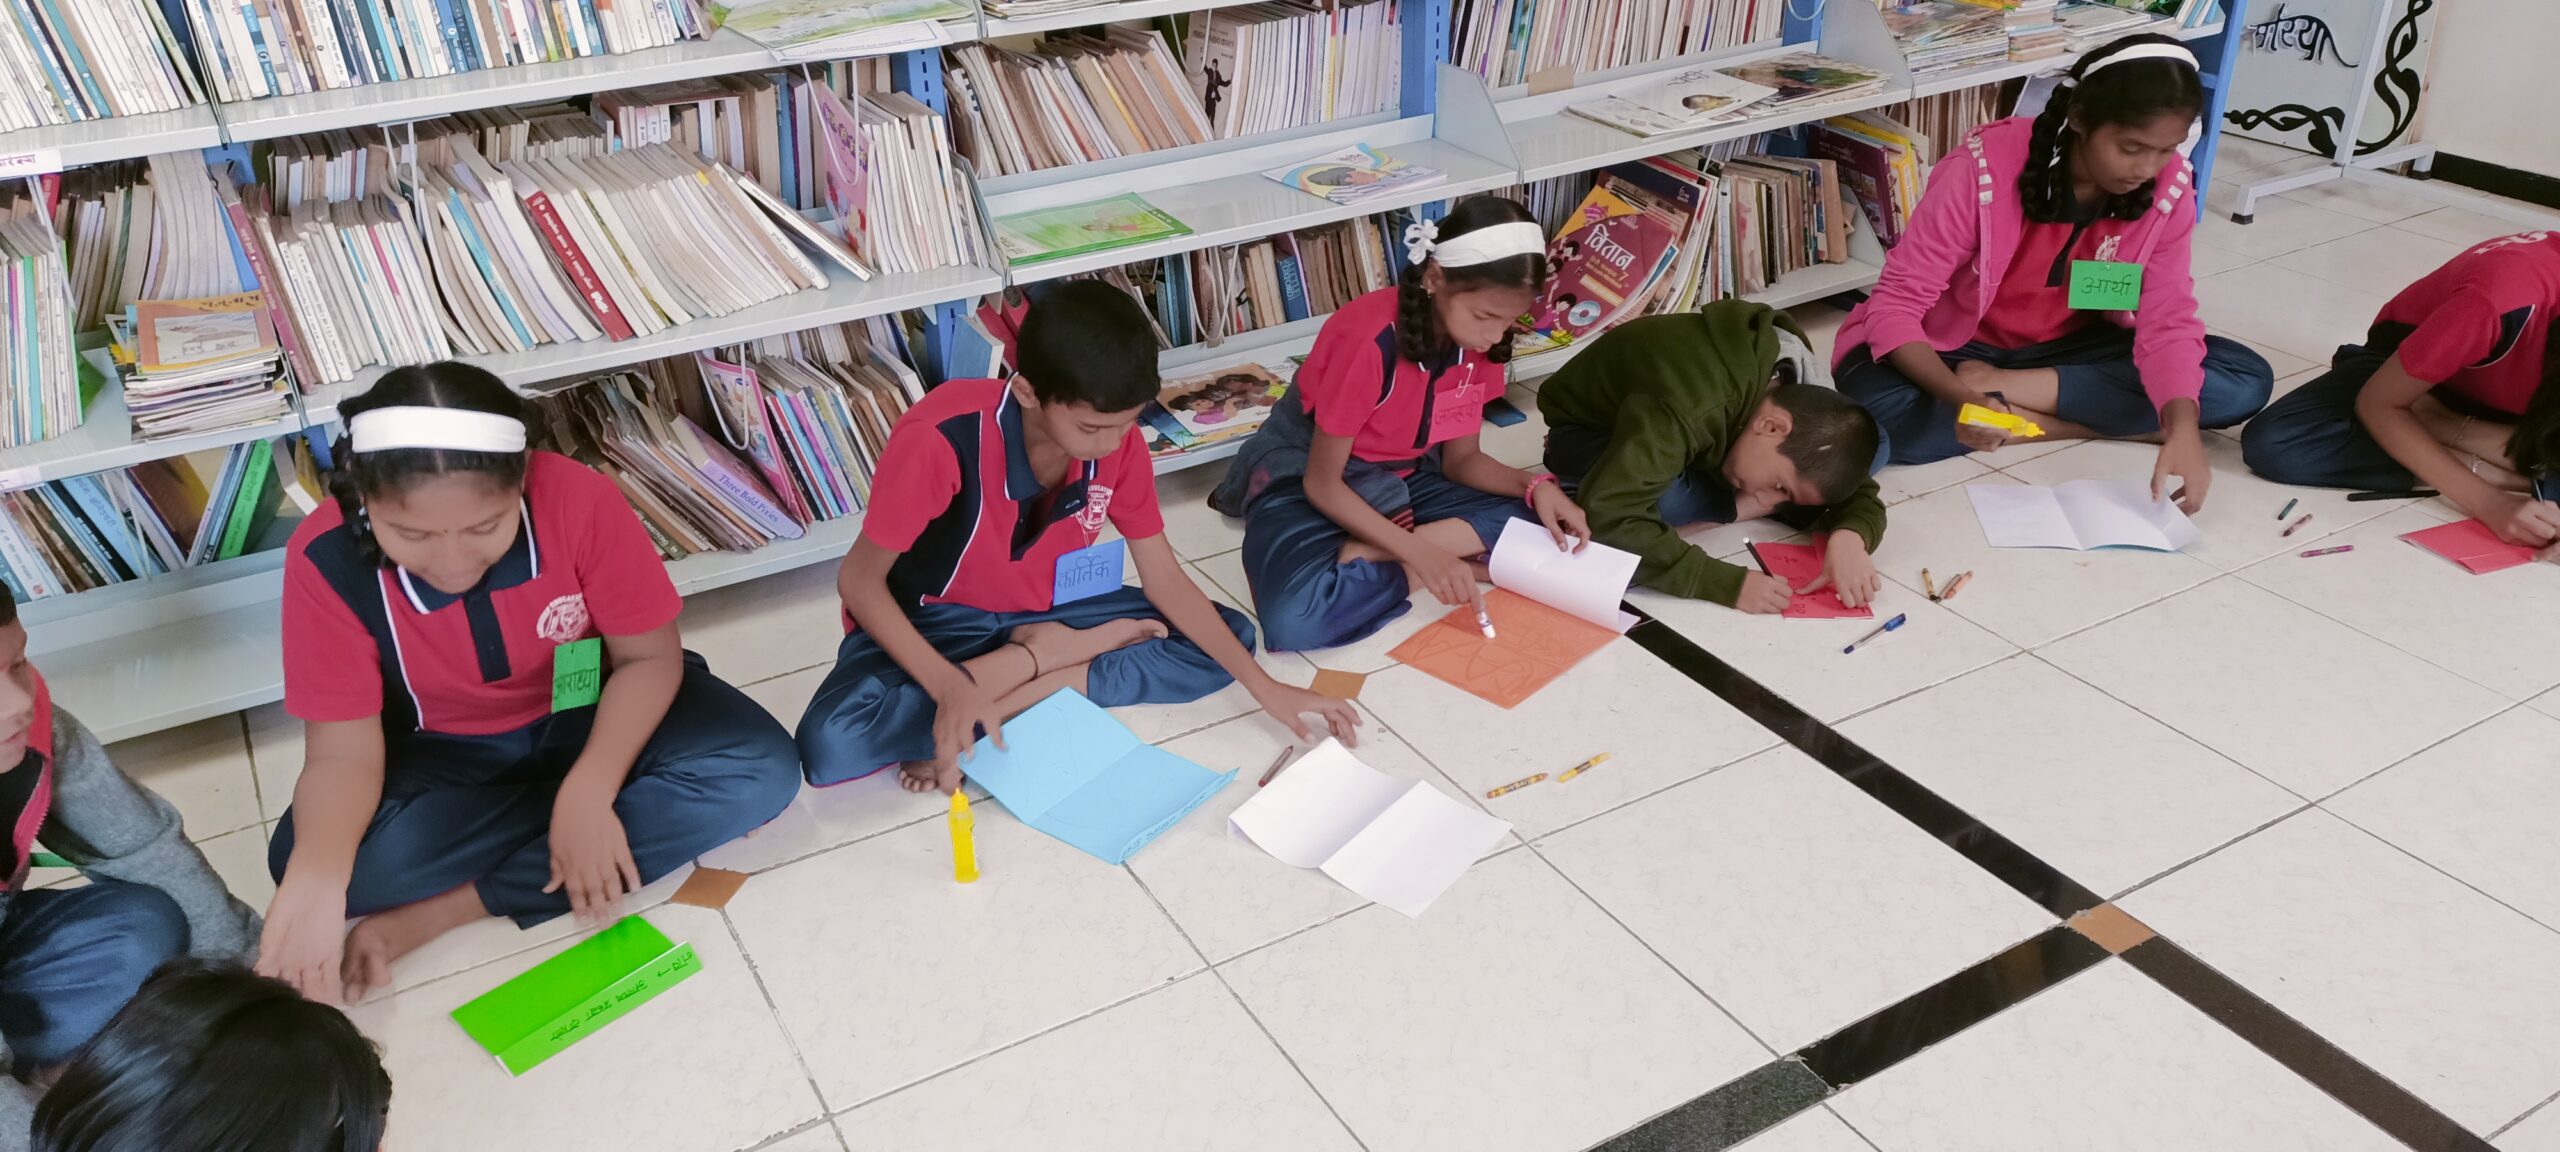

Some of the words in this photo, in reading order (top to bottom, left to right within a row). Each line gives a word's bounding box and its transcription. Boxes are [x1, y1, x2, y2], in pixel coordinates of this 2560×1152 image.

[1584, 223, 1636, 271] वितान
[719, 474, 741, 494] Three
[740, 490, 759, 507] Bold
[759, 502, 779, 522] Pixies
[1058, 556, 1112, 589] कार्तिक
